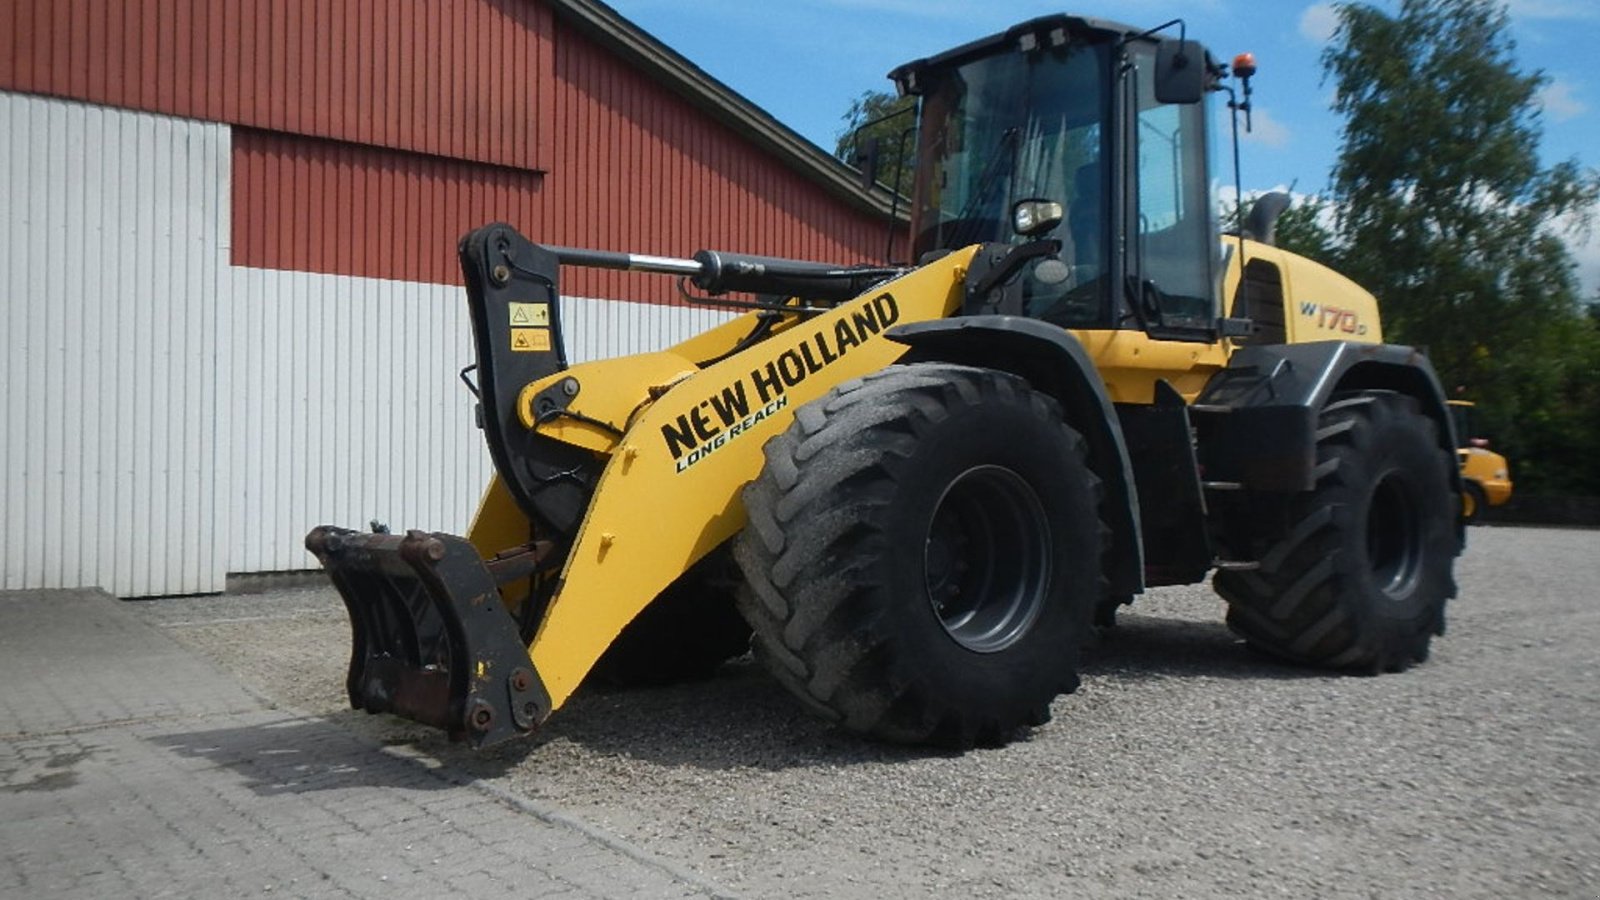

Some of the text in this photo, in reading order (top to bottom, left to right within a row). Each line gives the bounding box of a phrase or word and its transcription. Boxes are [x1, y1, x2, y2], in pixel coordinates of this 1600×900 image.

[661, 292, 900, 460] NEW HOLLAND
[676, 396, 788, 473] LONG REACH
